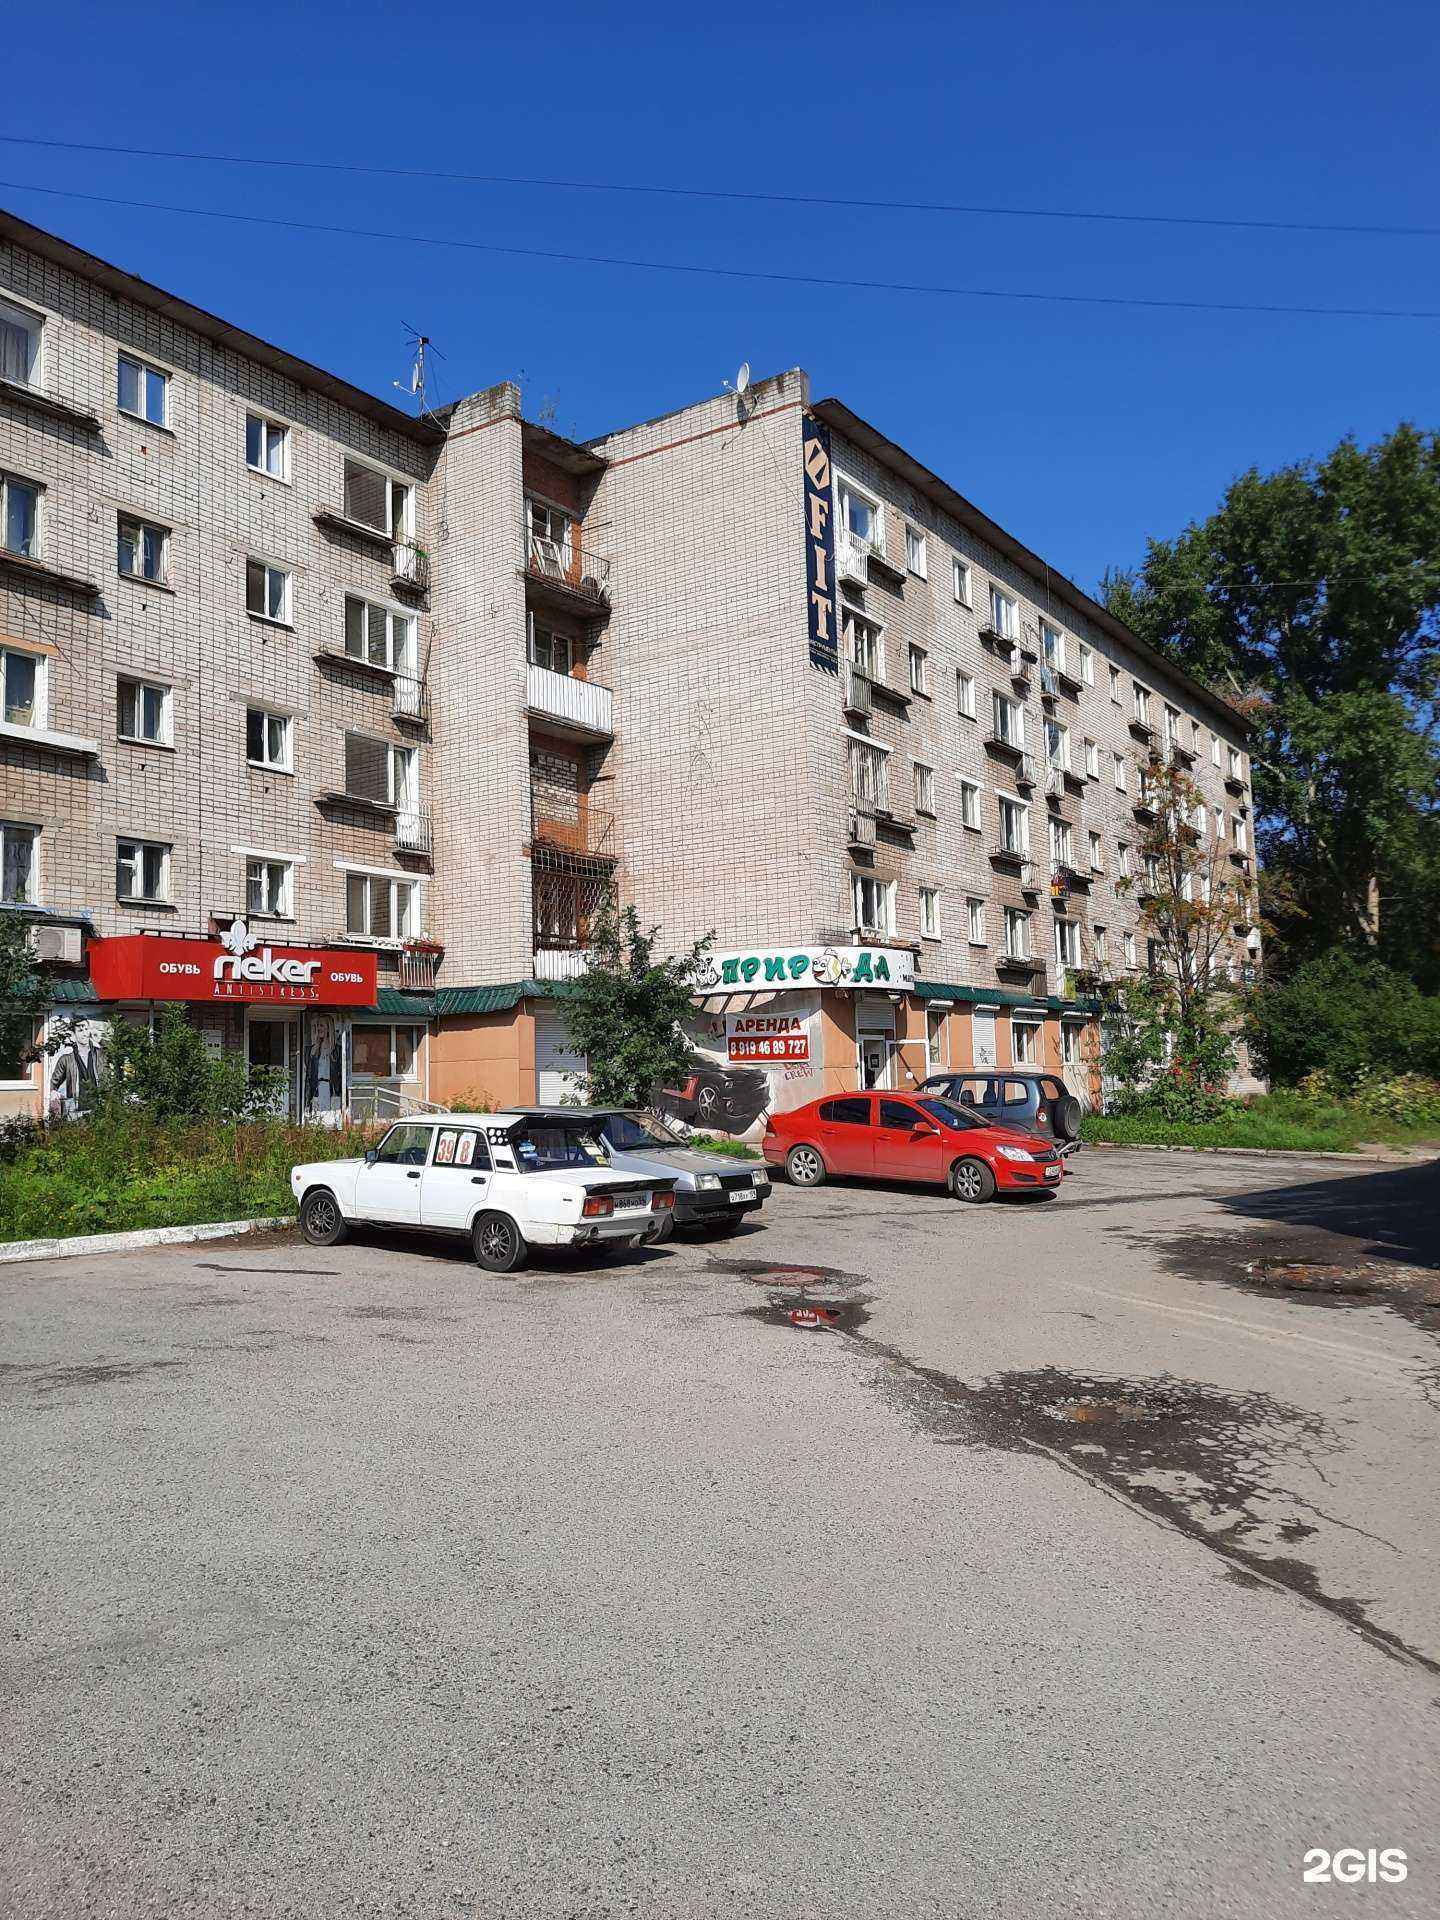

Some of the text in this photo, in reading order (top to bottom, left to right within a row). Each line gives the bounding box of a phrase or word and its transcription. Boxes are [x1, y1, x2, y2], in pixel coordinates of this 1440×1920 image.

[159, 963, 201, 975] ОБУВЬ
[330, 972, 364, 983] ОБУВЬ
[735, 1017, 801, 1033] АРЕНДА
[730, 1040, 806, 1055] 8 919 46 89 727
[438, 1138, 455, 1162] 39
[460, 1140, 471, 1163] 8
